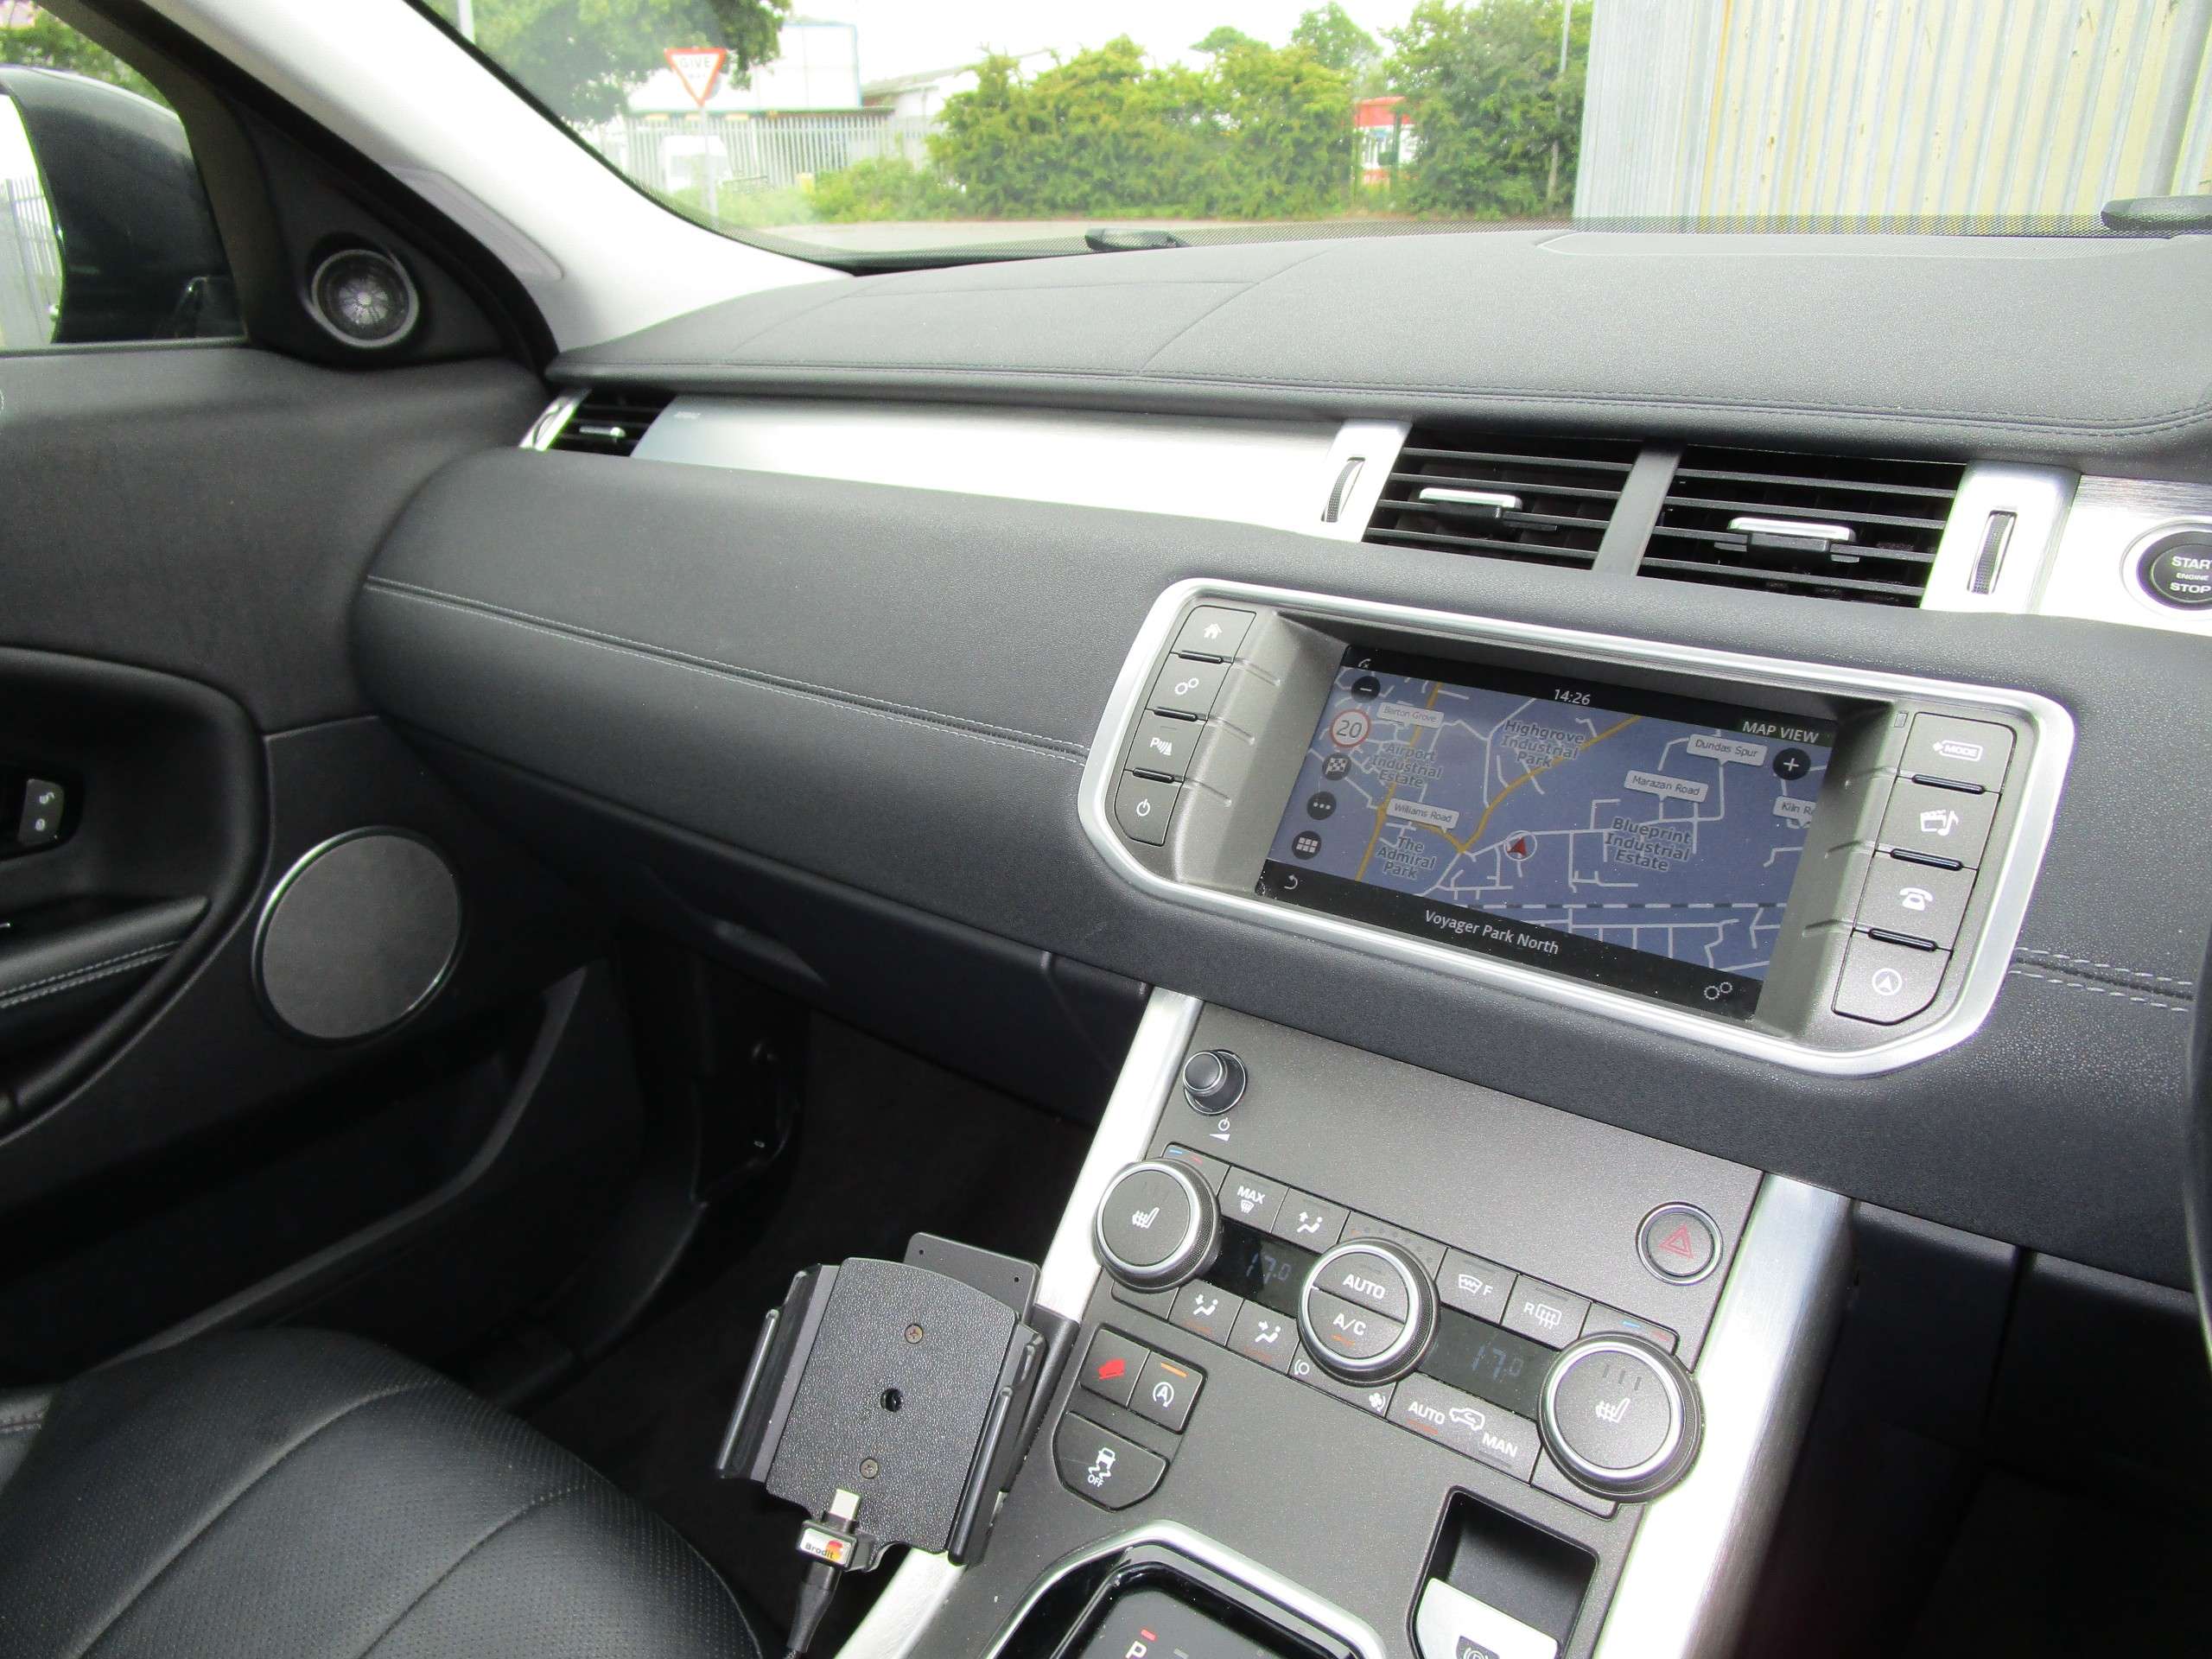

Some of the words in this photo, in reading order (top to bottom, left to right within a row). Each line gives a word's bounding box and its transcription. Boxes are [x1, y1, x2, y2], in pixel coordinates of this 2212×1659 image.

[679, 56, 711, 68] GIVE
[2171, 556, 2212, 570] STAR
[2176, 572, 2209, 581] ENGINE
[2170, 582, 2212, 594] STOP
[1554, 689, 1591, 705] 14:26
[1336, 720, 1363, 738] 20
[1504, 720, 1585, 744] Highgrove
[1742, 721, 1777, 735] MAP
[1780, 727, 1819, 743] VIEW
[1385, 742, 1437, 762] Airport
[1501, 735, 1580, 760] Industrial
[1695, 739, 1732, 753] Dundas
[1734, 746, 1758, 758] Spur
[1944, 745, 1978, 757] MODE
[1371, 754, 1443, 778] Industrial
[1516, 751, 1552, 767] Park
[1378, 769, 1424, 787] Estate
[1632, 776, 1672, 790] Marazan
[1675, 784, 1700, 795] Road
[1394, 802, 1427, 817] Williams
[1430, 810, 1452, 823] Road
[1781, 802, 1801, 813] Kiln
[1612, 817, 1691, 843] Blueprint
[1397, 836, 1424, 852] The
[1605, 833, 1690, 861] Industrial
[1377, 847, 1436, 869] Admiral
[1615, 849, 1669, 871] Estate
[1384, 861, 1417, 879] Park
[1426, 910, 1480, 934] Voyager
[1482, 925, 1515, 943] Park
[1516, 933, 1559, 955] North
[1237, 1185, 1266, 1205] MAX
[1343, 1274, 1385, 1300] AUTO
[1483, 1284, 1494, 1297] F
[1523, 1302, 1535, 1315] R
[1332, 1310, 1366, 1336] A/C
[1408, 1402, 1446, 1425] AUTO
[1482, 1431, 1518, 1458] MAN
[1088, 1474, 1104, 1488] OFF
[804, 1542, 835, 1560] Brodit
[1125, 1641, 1147, 1659] P
